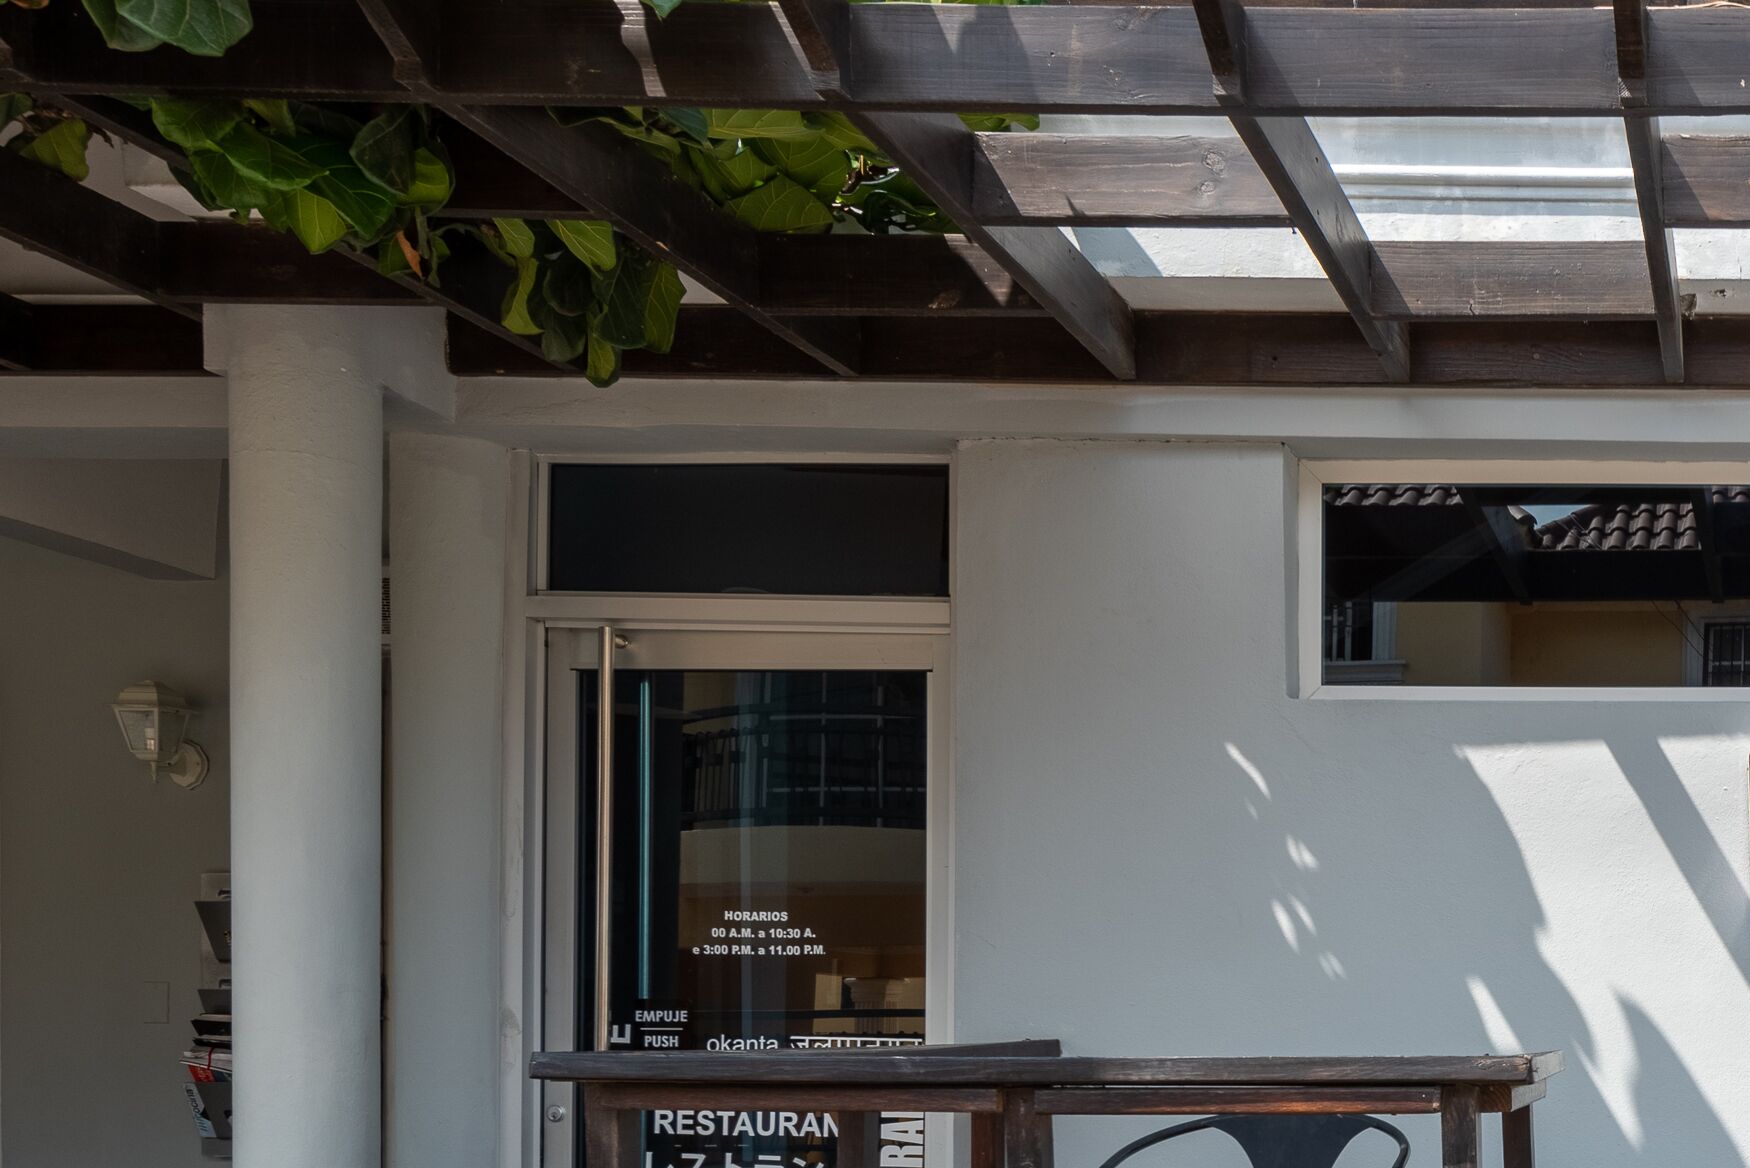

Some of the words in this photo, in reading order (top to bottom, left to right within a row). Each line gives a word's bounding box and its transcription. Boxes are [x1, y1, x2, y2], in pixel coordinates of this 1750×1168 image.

[724, 910, 789, 921] HORARIOS
[711, 928, 726, 938] 00
[729, 927, 755, 938] A.M.
[758, 930, 766, 938] a
[769, 928, 801, 939] 10:30
[692, 946, 700, 955] e
[703, 944, 729, 955] 3:00
[731, 944, 755, 955] P.M.
[758, 947, 766, 955] a
[803, 944, 826, 955] P.M.
[635, 1010, 688, 1022] EMPUJE
[644, 1035, 679, 1047] PUSH
